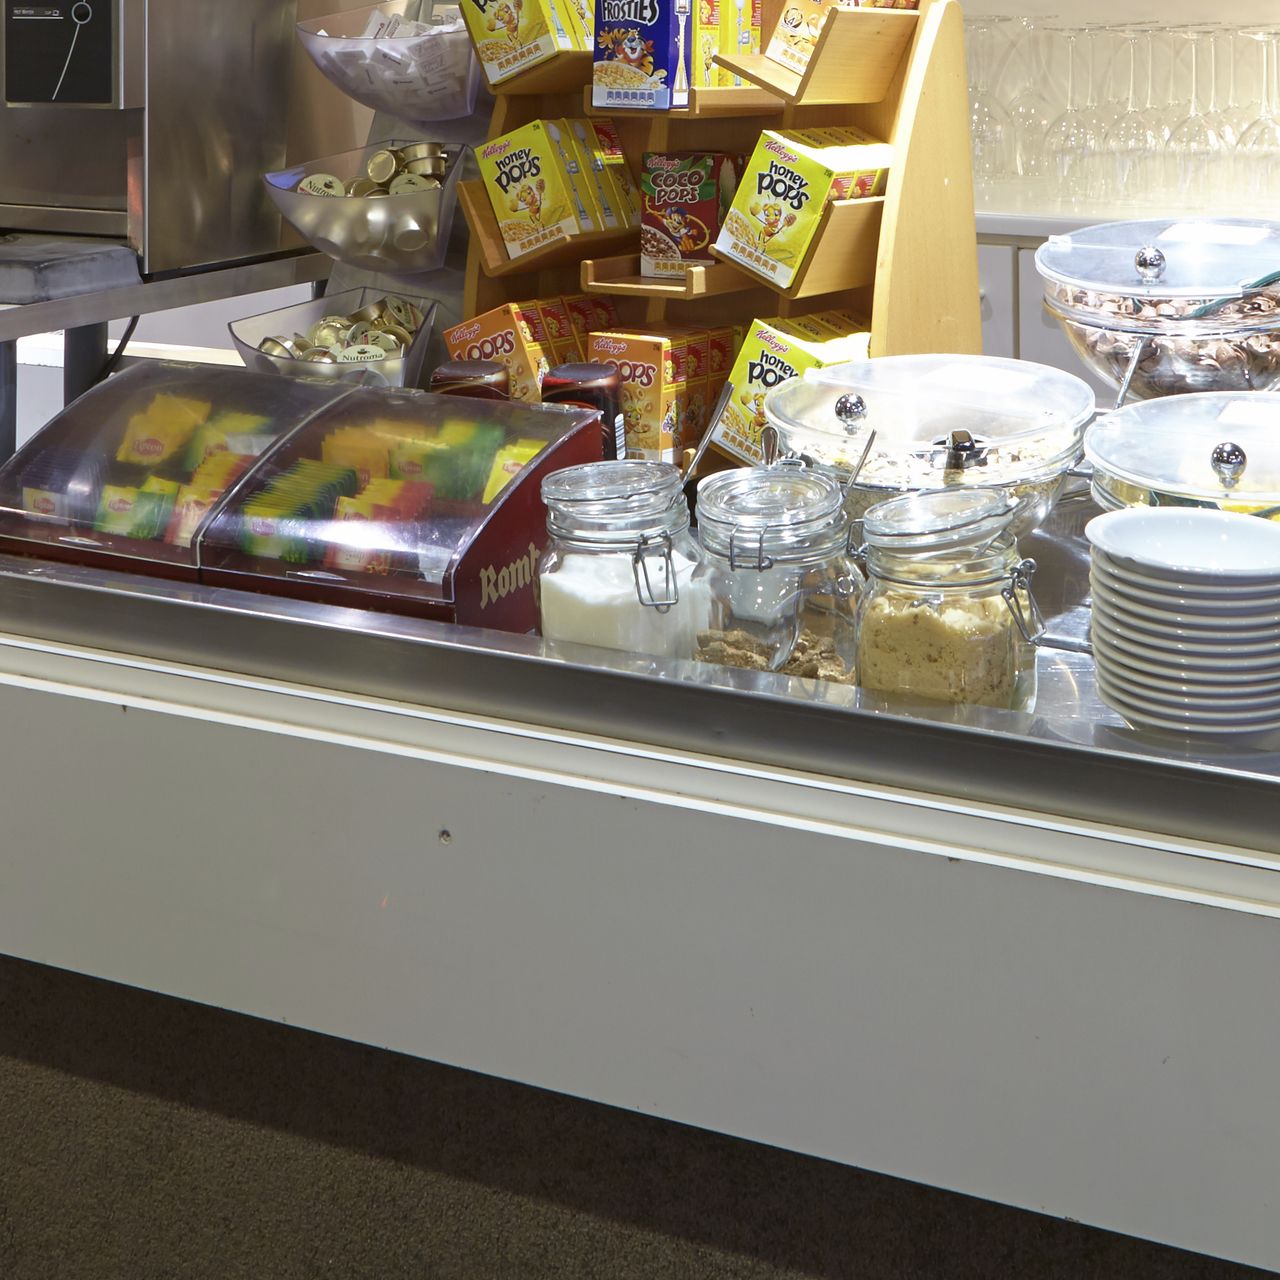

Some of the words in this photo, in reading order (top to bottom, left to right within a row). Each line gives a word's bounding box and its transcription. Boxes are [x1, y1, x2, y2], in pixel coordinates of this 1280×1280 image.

[496, 147, 532, 172] honey
[764, 140, 798, 163] Kellogg's
[650, 168, 706, 189] COCO
[769, 160, 809, 190] honey
[655, 186, 700, 206] POPS
[450, 323, 481, 344] Kellogg's
[756, 330, 789, 354] Kellogg's
[594, 337, 627, 355] Kellogg's
[342, 353, 383, 362] Nutroma
[760, 350, 799, 378] honey
